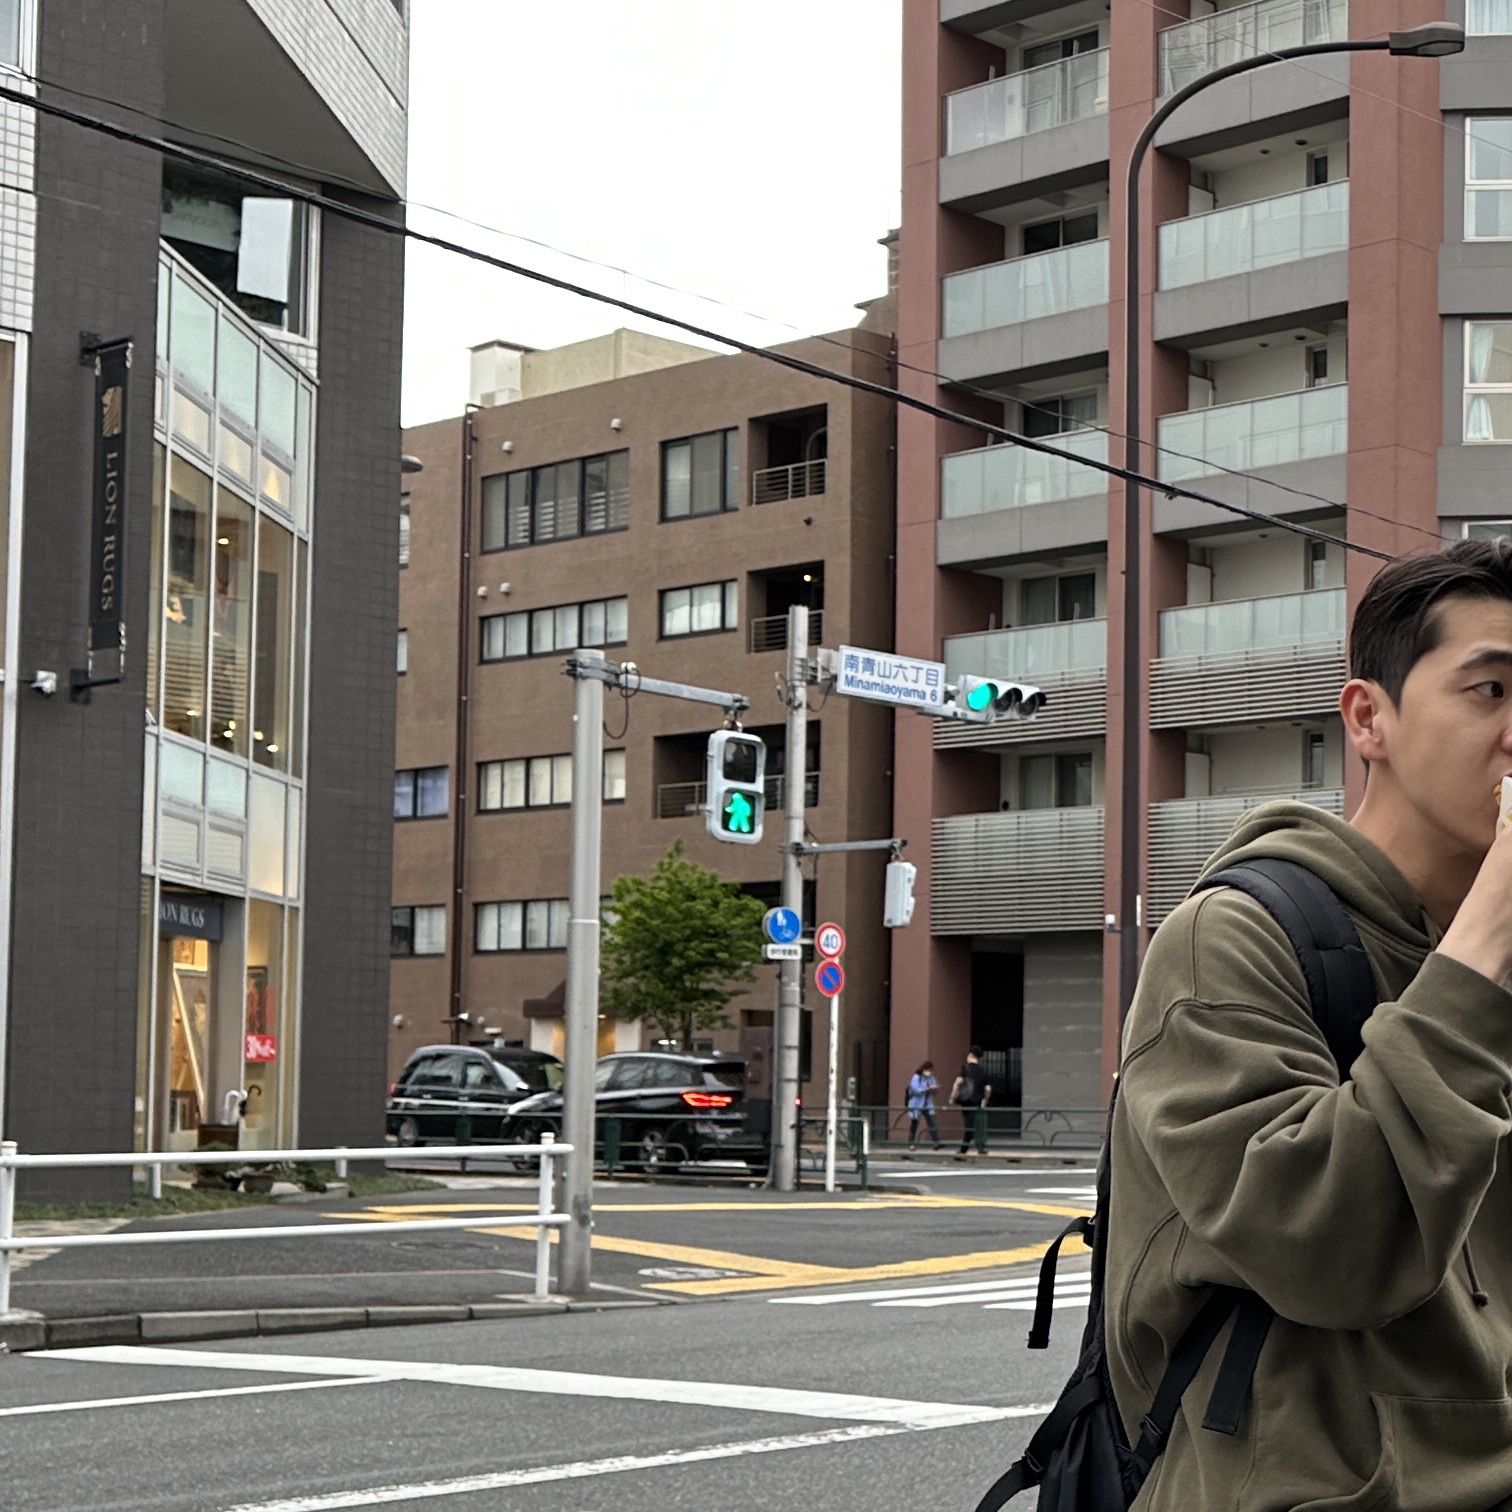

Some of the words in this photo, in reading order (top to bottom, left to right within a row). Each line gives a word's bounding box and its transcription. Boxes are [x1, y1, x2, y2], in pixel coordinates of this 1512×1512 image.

[104, 451, 118, 525] LION
[101, 535, 116, 611] RUGS
[844, 653, 940, 687] 南青山六丁目
[843, 673, 927, 701] Minamiaoyama
[929, 689, 938, 702] 6
[822, 933, 839, 950] 40
